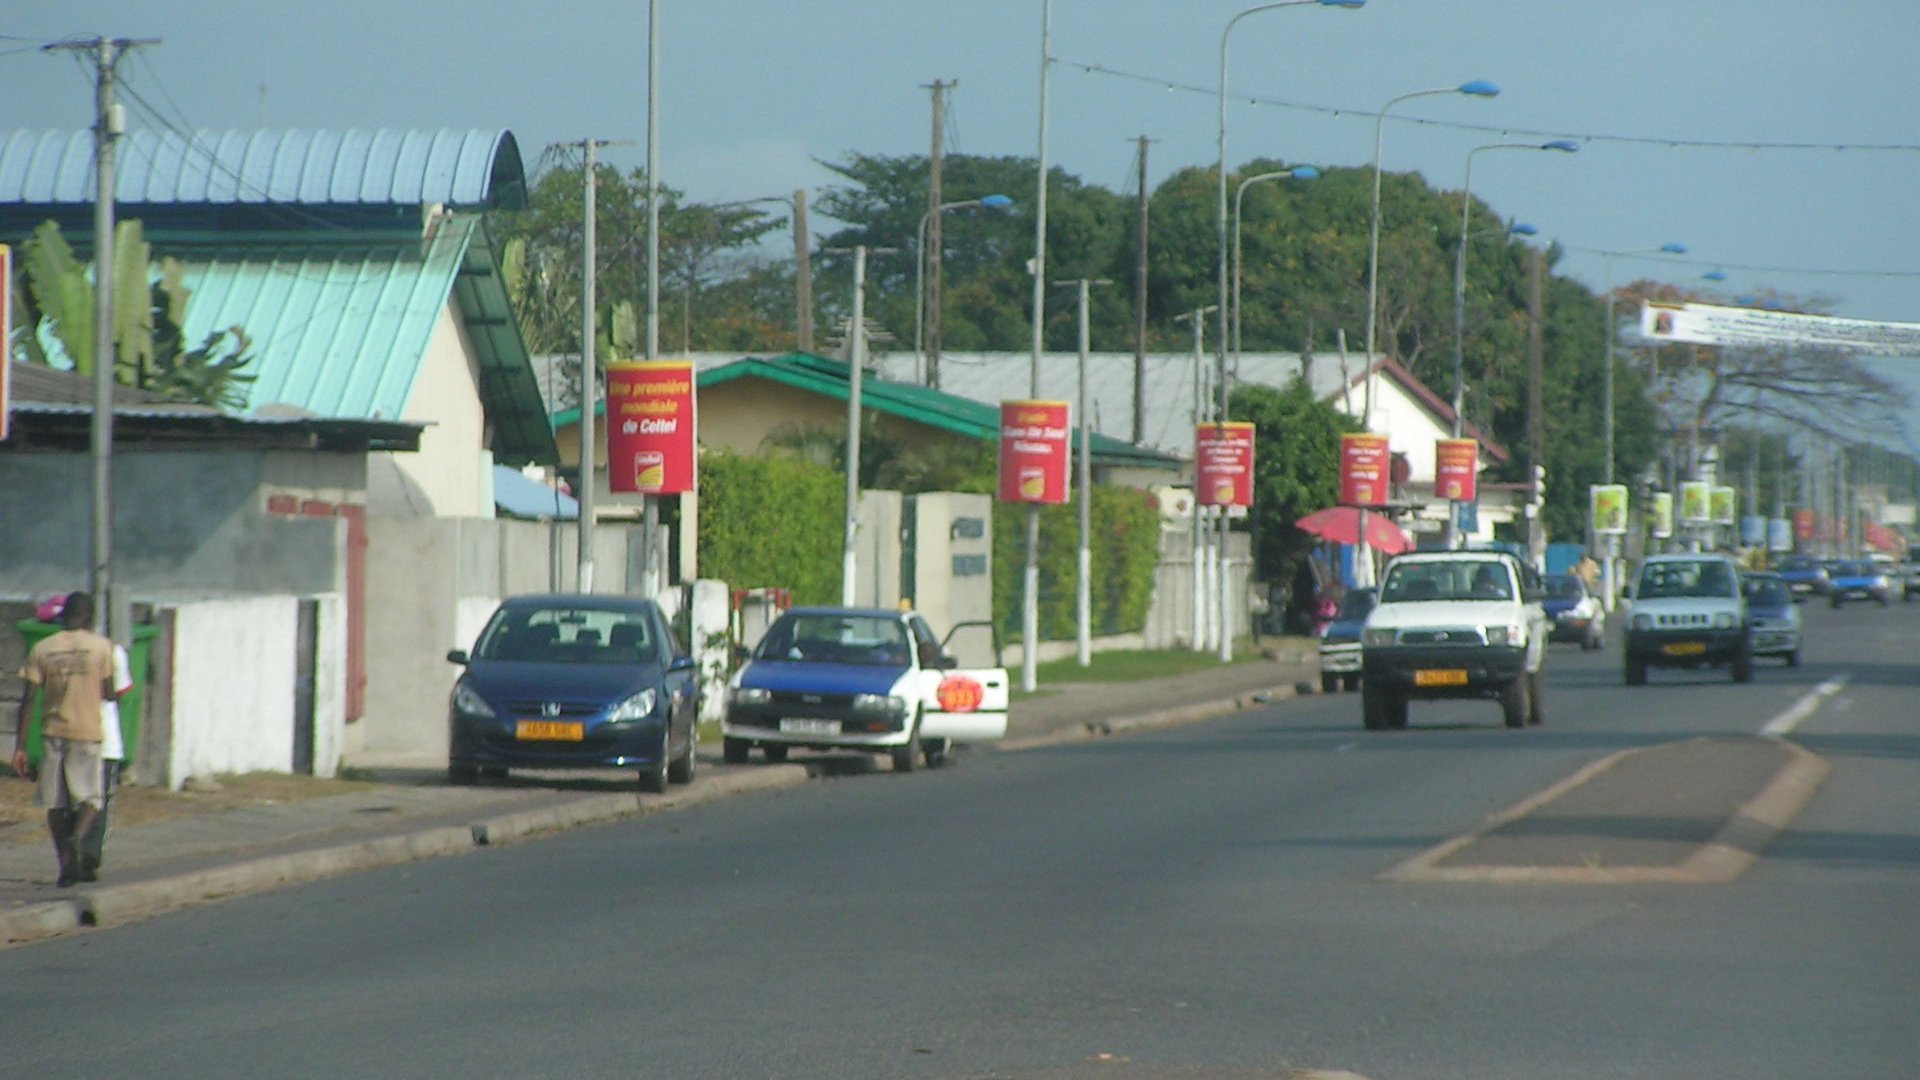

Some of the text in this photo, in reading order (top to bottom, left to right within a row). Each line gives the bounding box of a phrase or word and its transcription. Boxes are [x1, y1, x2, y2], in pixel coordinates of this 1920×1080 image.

[621, 401, 677, 415] mondiale
[622, 418, 677, 434] de Celtel
